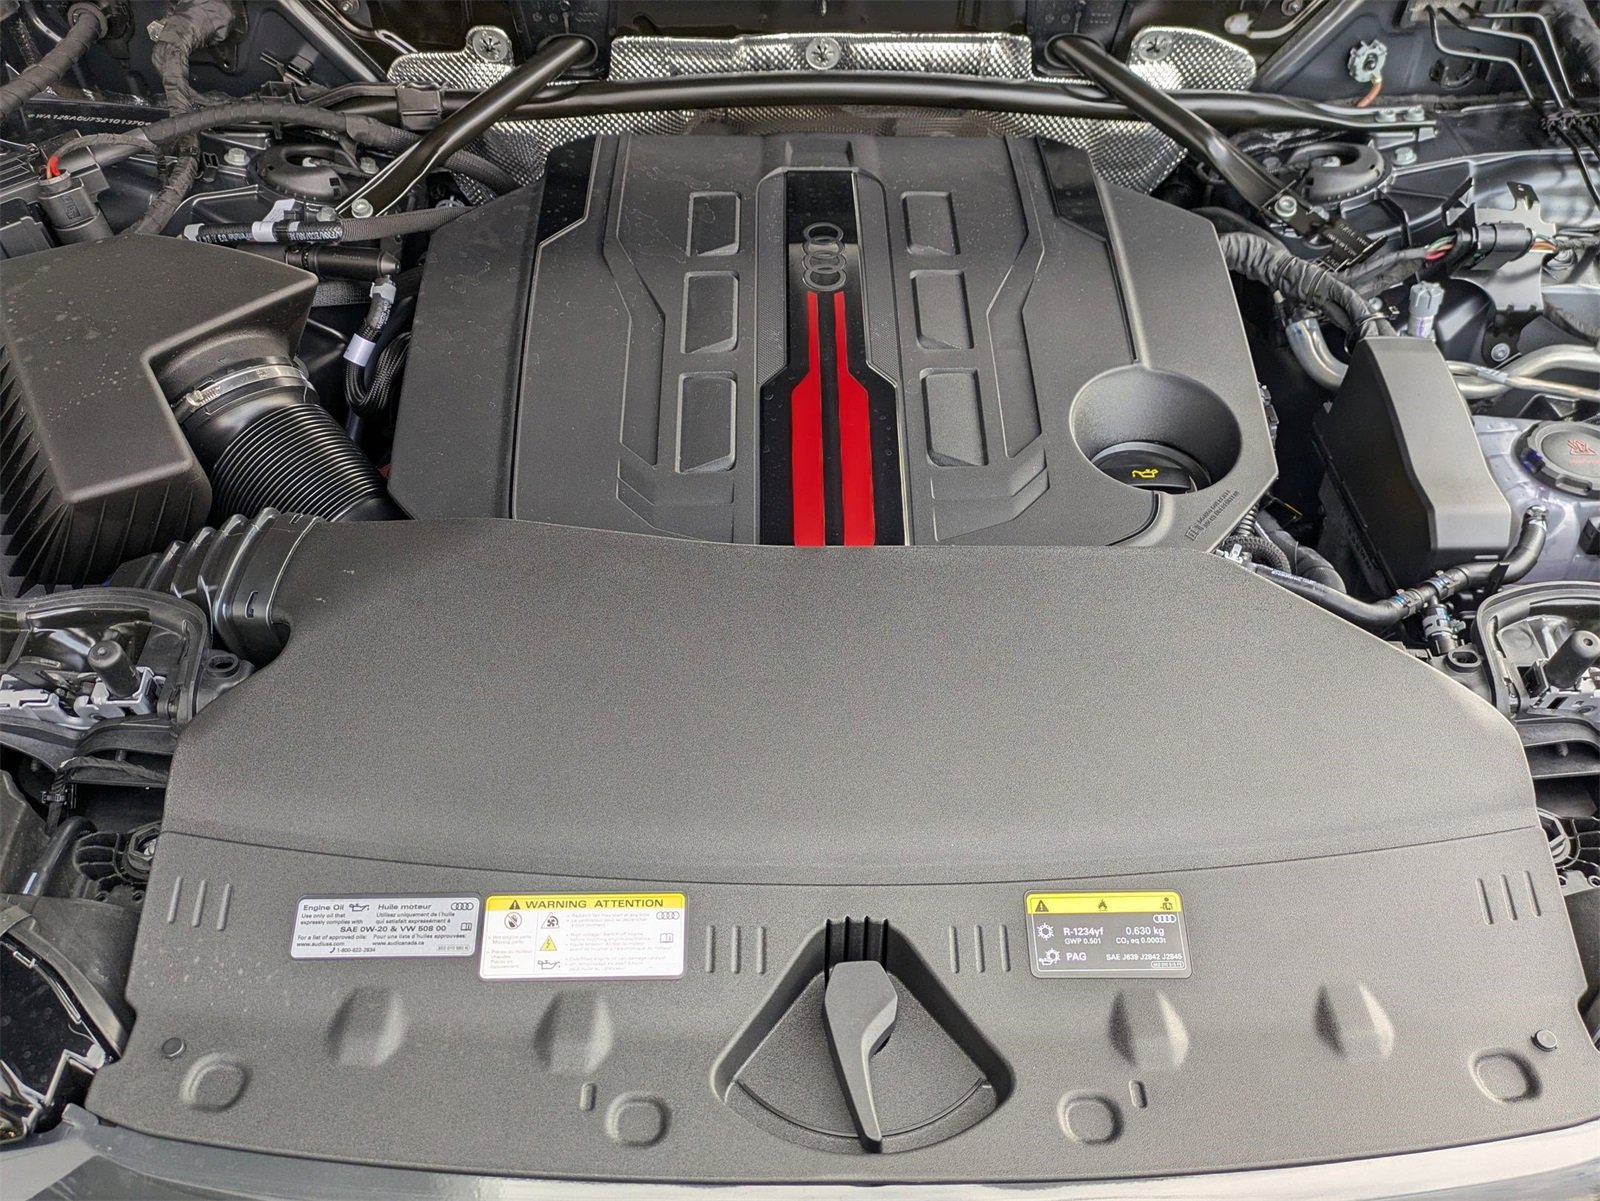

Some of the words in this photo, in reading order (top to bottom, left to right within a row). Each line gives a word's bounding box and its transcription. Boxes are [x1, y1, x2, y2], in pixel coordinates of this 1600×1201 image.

[303, 904, 331, 912] Engine
[525, 899, 587, 909] WARNING
[593, 898, 664, 908] ATTENTION
[1063, 926, 1104, 937] R-1234yf
[1126, 926, 1152, 936] 0.630
[1153, 926, 1165, 937] kg
[1066, 952, 1088, 962] PAG
[1106, 953, 1122, 961] SAE
